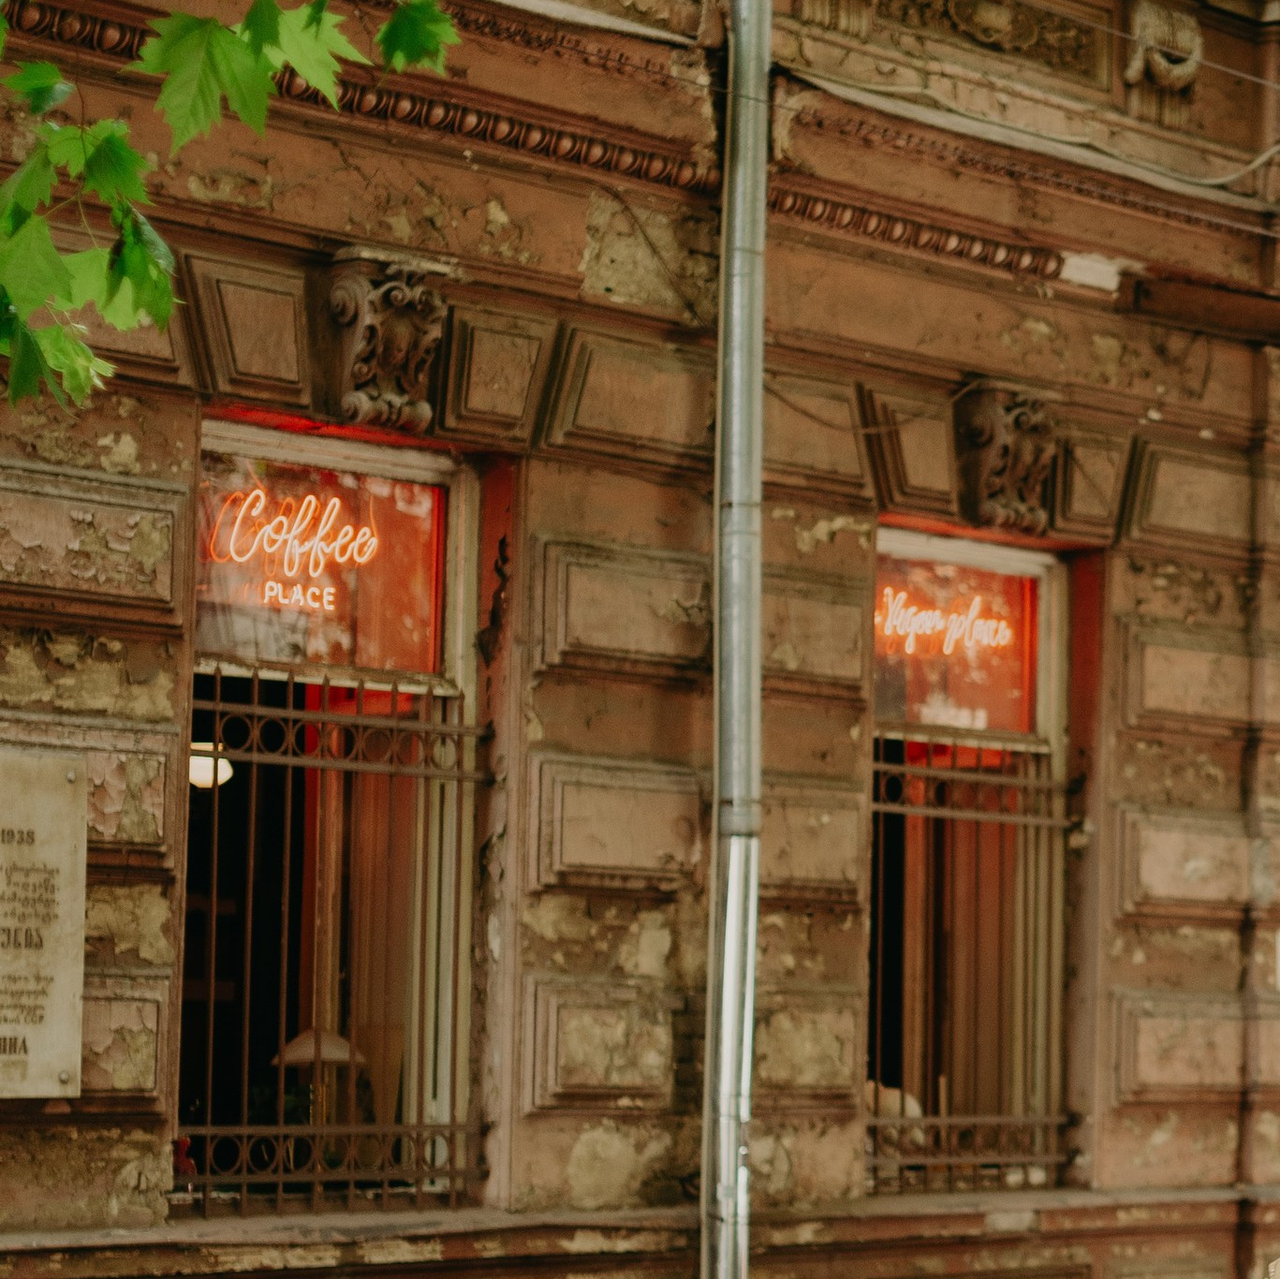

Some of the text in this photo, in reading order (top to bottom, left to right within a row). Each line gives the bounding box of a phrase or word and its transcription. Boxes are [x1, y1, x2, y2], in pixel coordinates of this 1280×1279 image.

[229, 488, 379, 578] Coffee
[263, 580, 337, 611] PLACE
[1, 827, 36, 846] 1938
